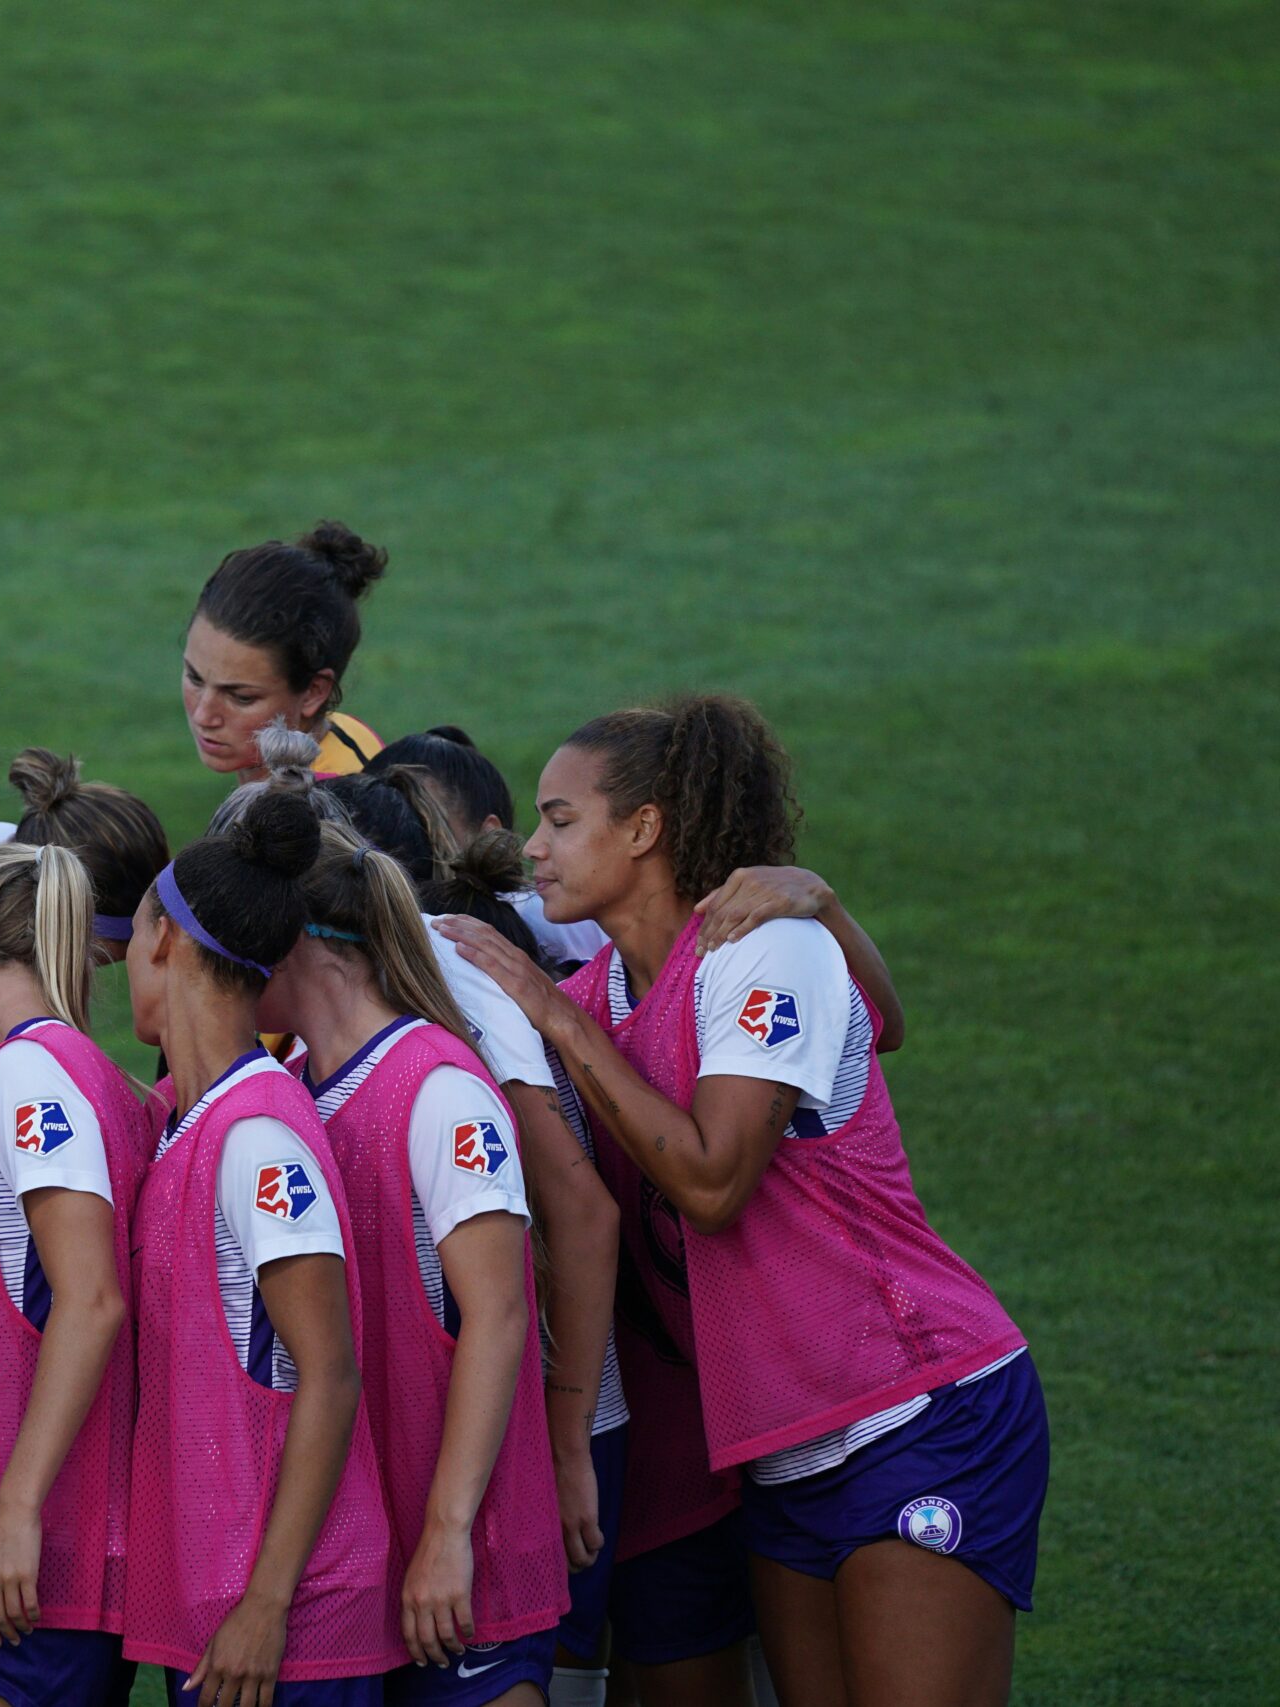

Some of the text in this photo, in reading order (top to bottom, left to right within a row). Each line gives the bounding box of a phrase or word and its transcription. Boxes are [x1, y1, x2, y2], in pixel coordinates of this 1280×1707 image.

[772, 1014, 797, 1027] NWSL
[43, 1122, 69, 1131] NWSL
[485, 1142, 504, 1152] NWSL
[289, 1185, 312, 1195] NWSL
[904, 1499, 951, 1518] ORLANDO
